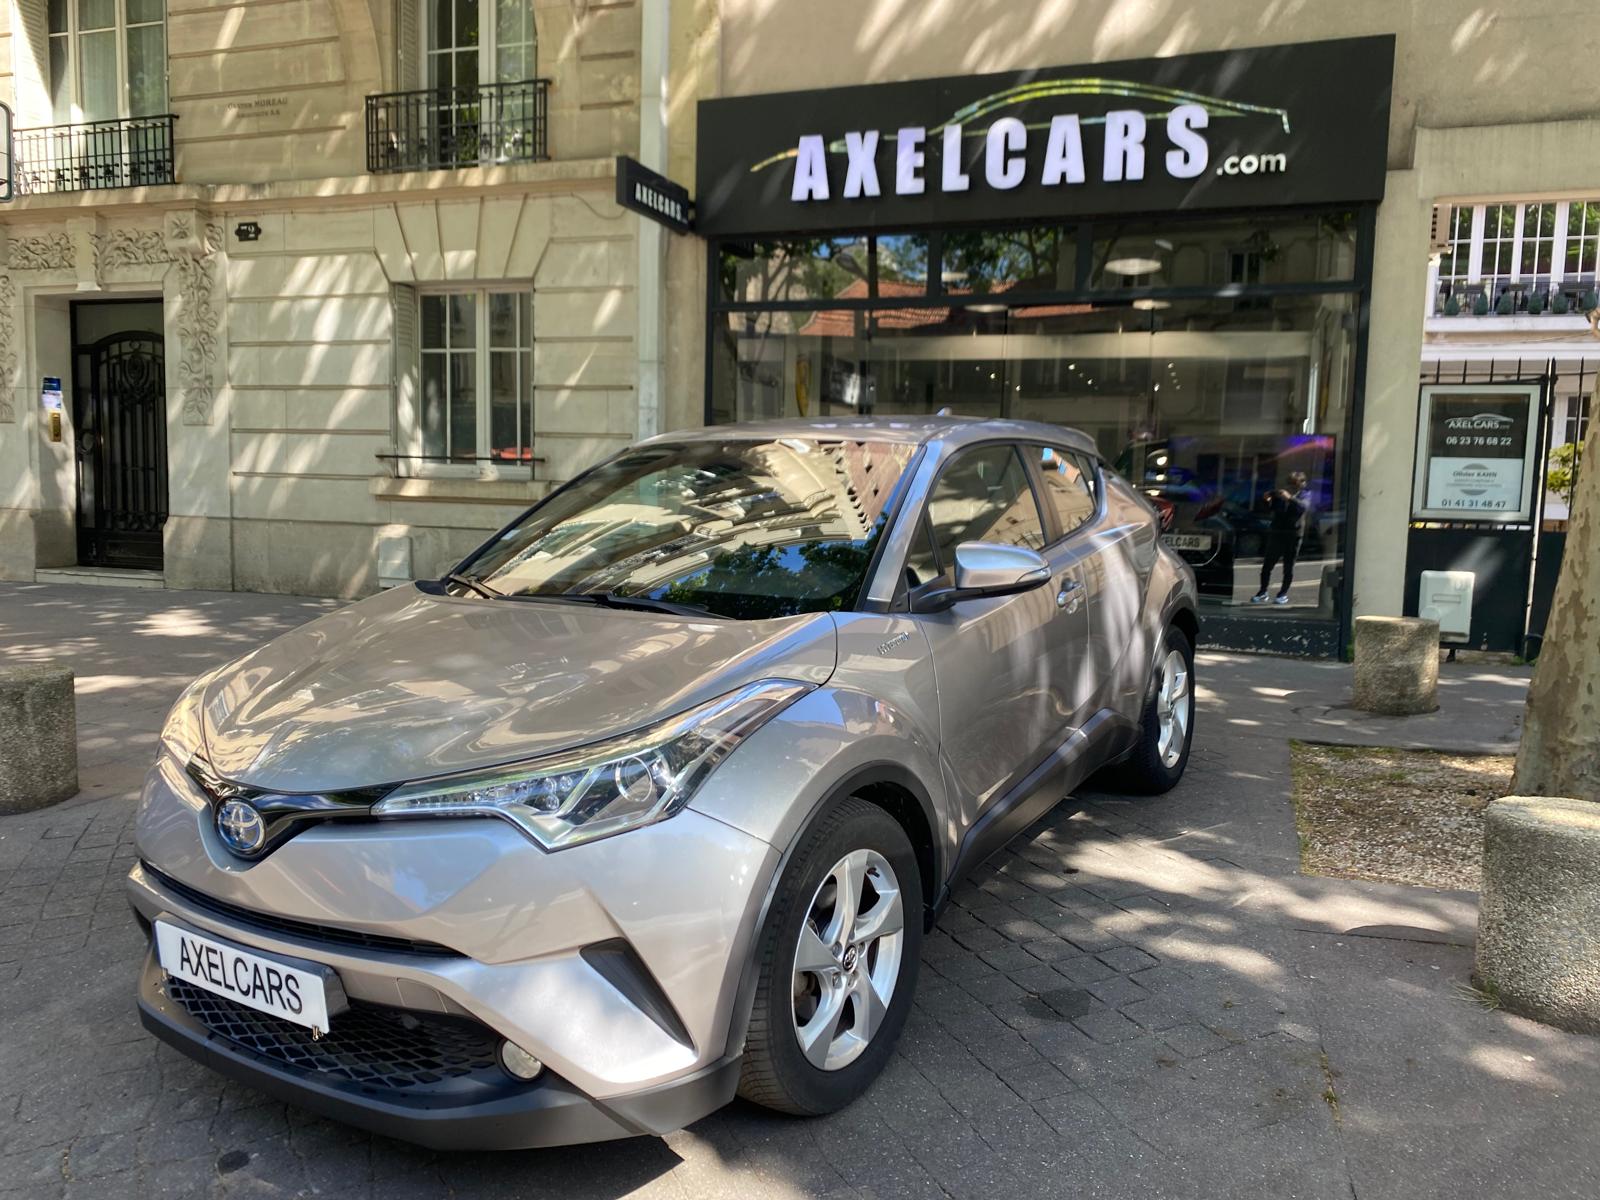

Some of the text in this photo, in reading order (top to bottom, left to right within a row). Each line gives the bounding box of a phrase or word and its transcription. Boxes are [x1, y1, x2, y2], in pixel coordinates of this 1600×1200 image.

[1446, 436, 1458, 446] 06
[1459, 436, 1471, 446] 23
[1499, 436, 1512, 446] 22
[1441, 498, 1452, 507] 01
[1455, 499, 1465, 507] 41
[1468, 499, 1479, 507] 31
[1495, 500, 1506, 508] 47
[180, 936, 303, 1015] AXELCARS
